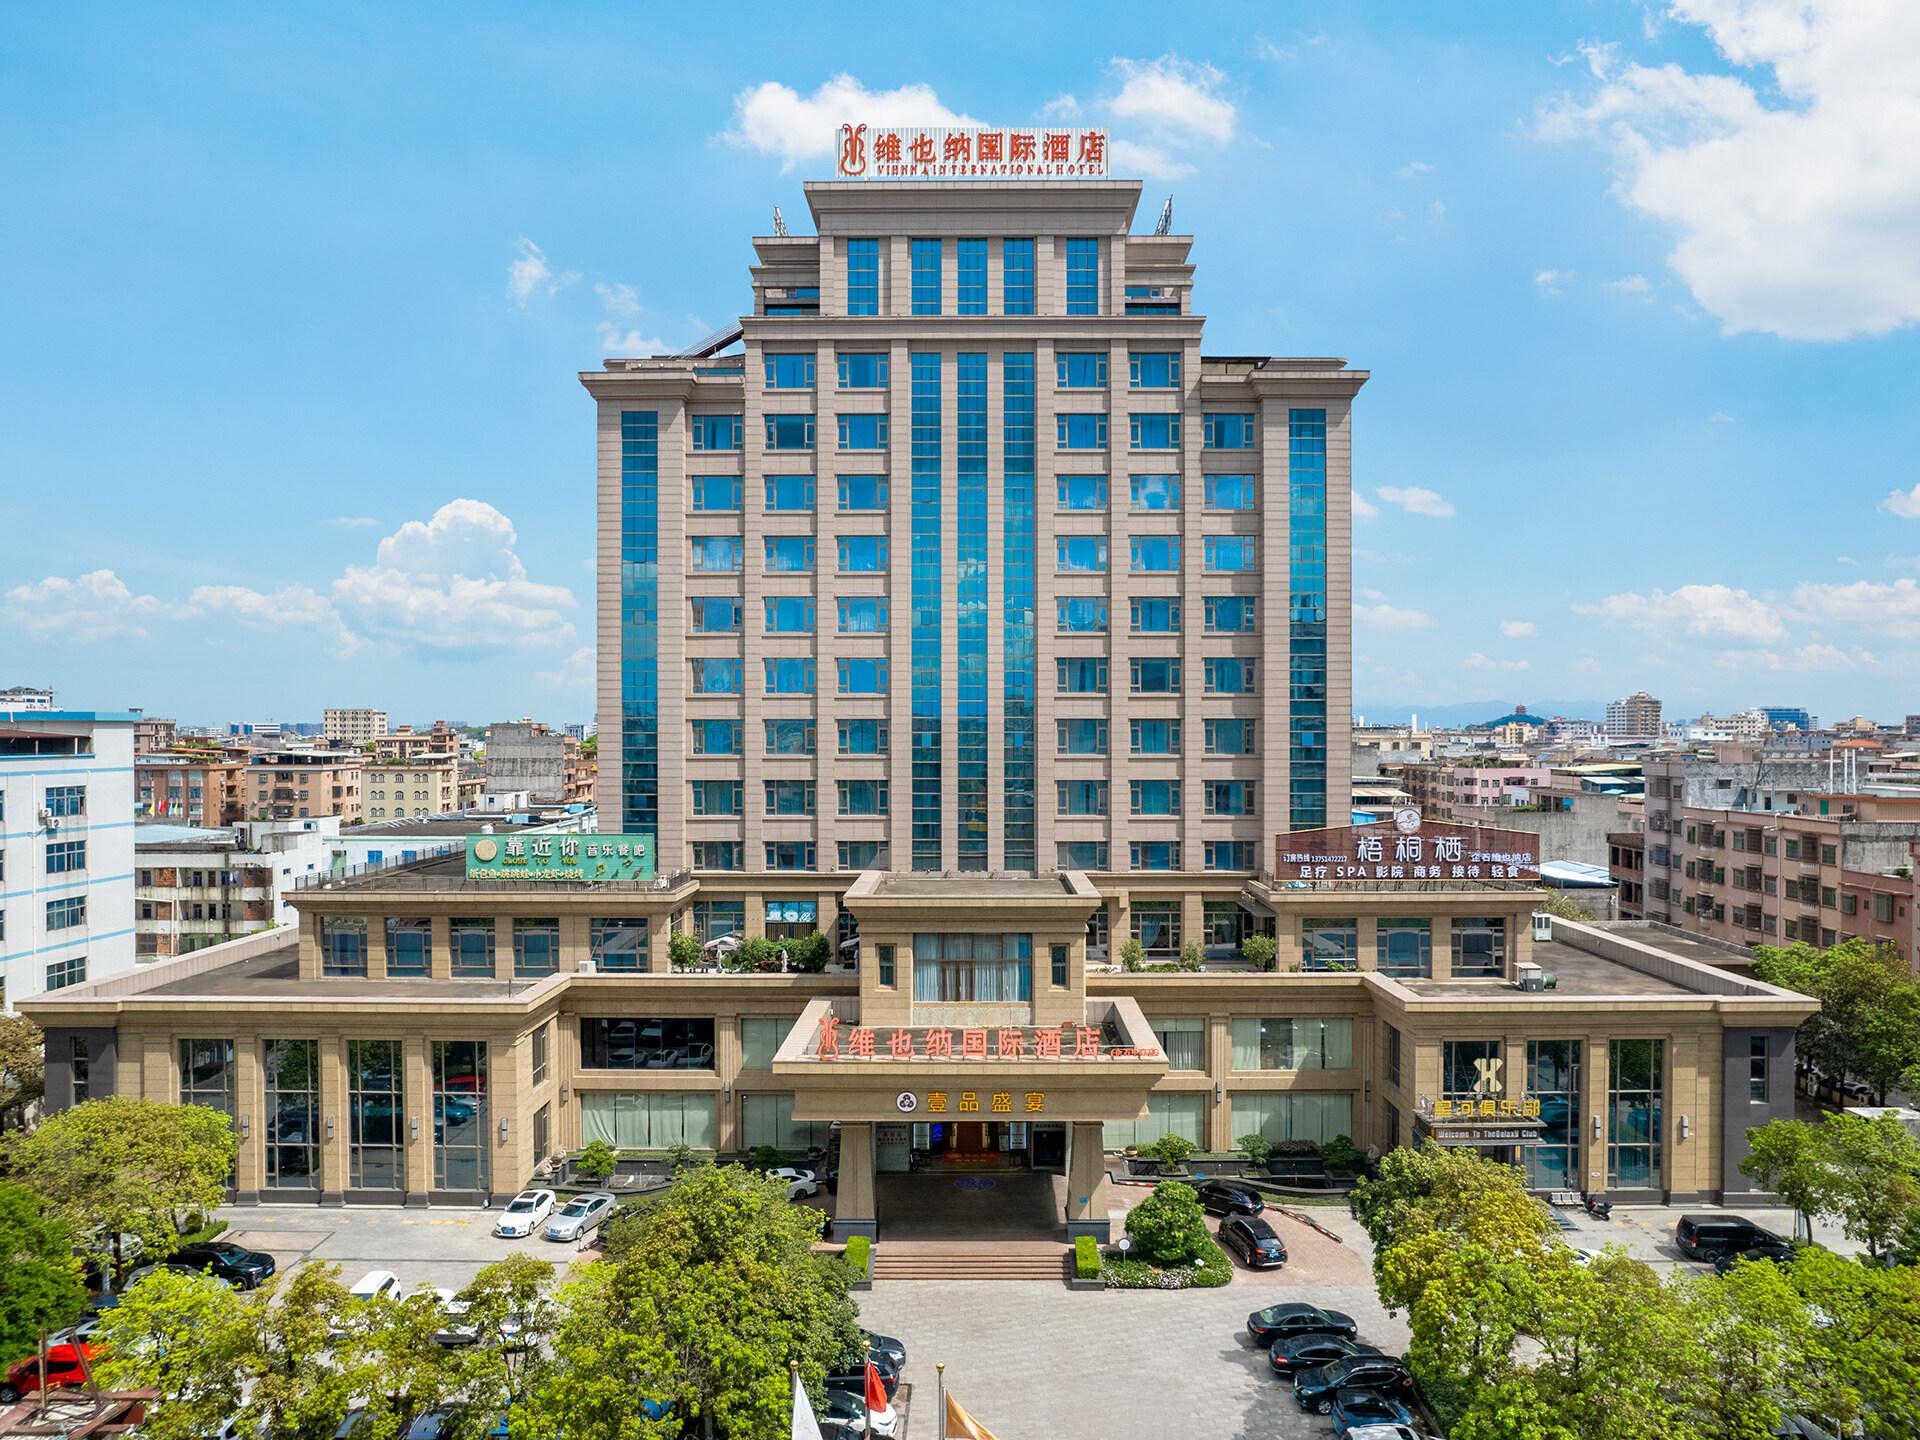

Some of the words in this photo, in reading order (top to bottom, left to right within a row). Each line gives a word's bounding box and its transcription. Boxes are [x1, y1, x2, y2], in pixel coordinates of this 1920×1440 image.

[875, 132, 1105, 163] 维也纳国际酒店
[506, 836, 579, 857] 靠近你
[586, 844, 646, 857] 音乐餐吧
[1357, 836, 1461, 862] 梧桐栖
[535, 857, 549, 865] TO
[1300, 865, 1328, 878] 足疗
[1336, 866, 1367, 877] SPA
[1375, 866, 1404, 878] 影院
[1413, 865, 1441, 878] 商务
[1451, 865, 1480, 878] 接待
[1491, 865, 1519, 878] 轻食
[848, 1027, 1101, 1058] 维也纳国际酒店
[927, 1091, 1046, 1113] 壹品盛宴
[1434, 1099, 1541, 1118] 星河俱乐部
[1438, 1130, 1470, 1138] Welcome
[1473, 1130, 1481, 1138] To
[1521, 1130, 1538, 1138] Club
